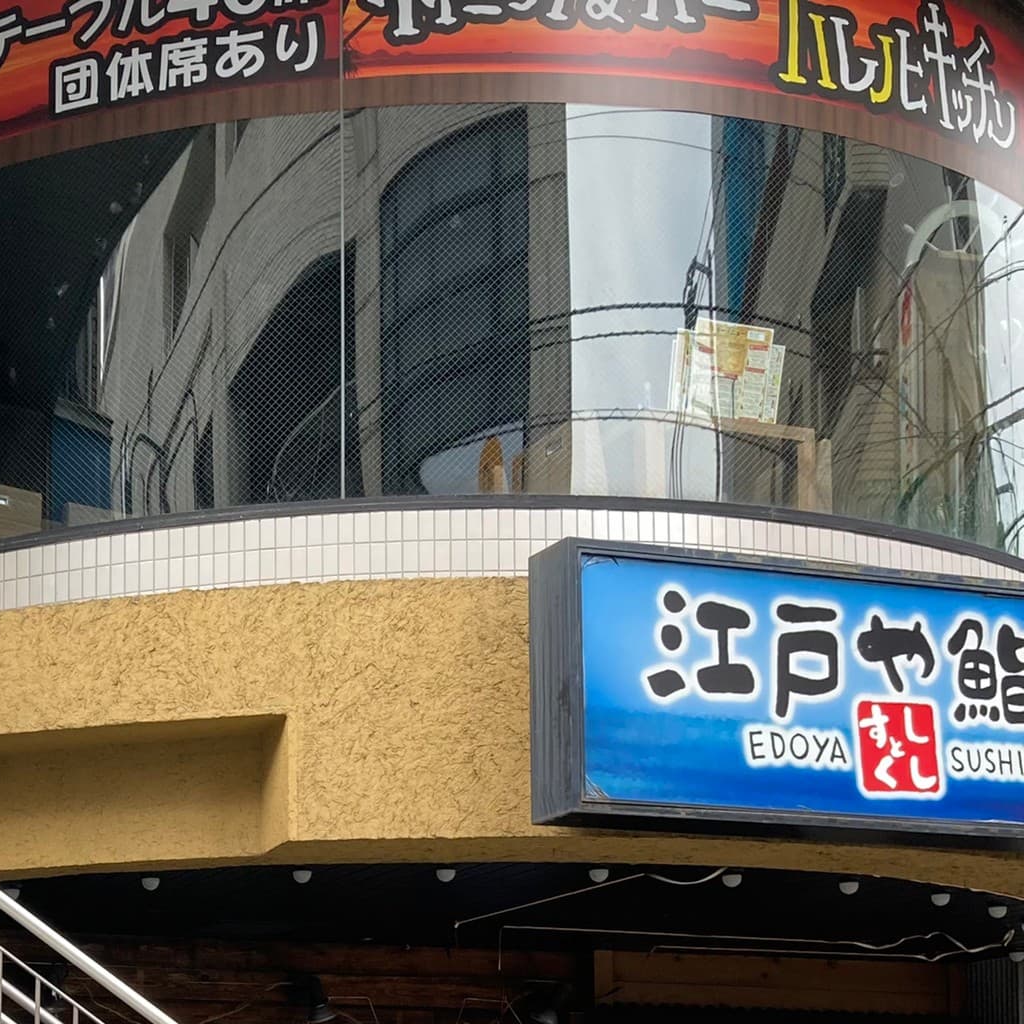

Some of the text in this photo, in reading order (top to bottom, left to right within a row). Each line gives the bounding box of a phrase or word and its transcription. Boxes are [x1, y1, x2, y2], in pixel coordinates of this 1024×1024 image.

[54, 20, 320, 114] 団体席あり
[749, 730, 847, 764] EDOYA
[951, 746, 1024, 775] SUSHI
